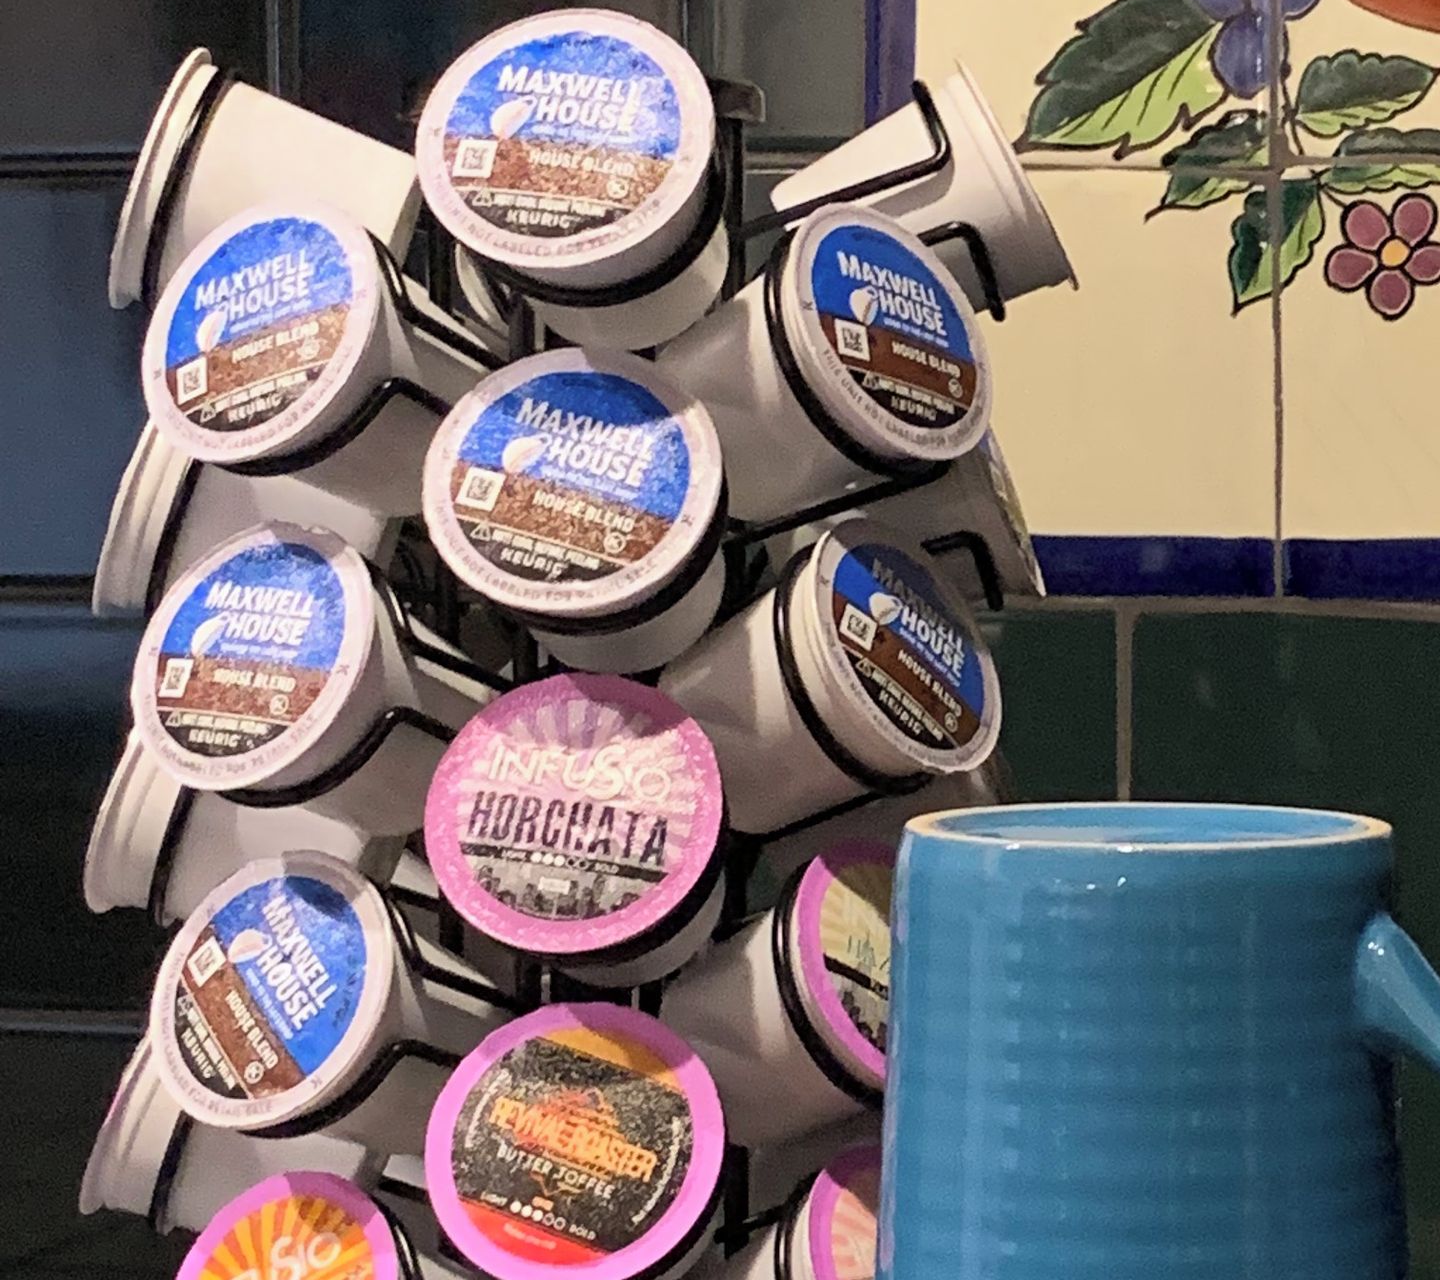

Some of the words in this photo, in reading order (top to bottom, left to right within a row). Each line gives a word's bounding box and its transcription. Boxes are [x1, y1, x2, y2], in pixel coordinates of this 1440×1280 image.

[498, 65, 641, 104] MAXWELL
[533, 98, 638, 130] HOUSE
[193, 248, 315, 310] MAXWELL
[228, 274, 311, 321] HOUSE
[837, 251, 941, 311] MAXWELL
[879, 294, 947, 336] HOUSE
[515, 398, 654, 459] MAXWELL
[548, 437, 649, 486] HOUSE
[205, 580, 314, 619] MAXWELL
[224, 613, 310, 646] HOUSE
[902, 606, 965, 678] HOUSE
[188, 729, 240, 748] KEURIG
[488, 745, 672, 801] INFUSIO
[466, 790, 668, 867] HORCHATA
[262, 895, 338, 1009] MAXWELL
[256, 945, 319, 1030] HOUSE
[496, 1142, 551, 1176] BUTTER
[552, 1164, 617, 1201] TOFFEE
[568, 1223, 597, 1241] BOLD
